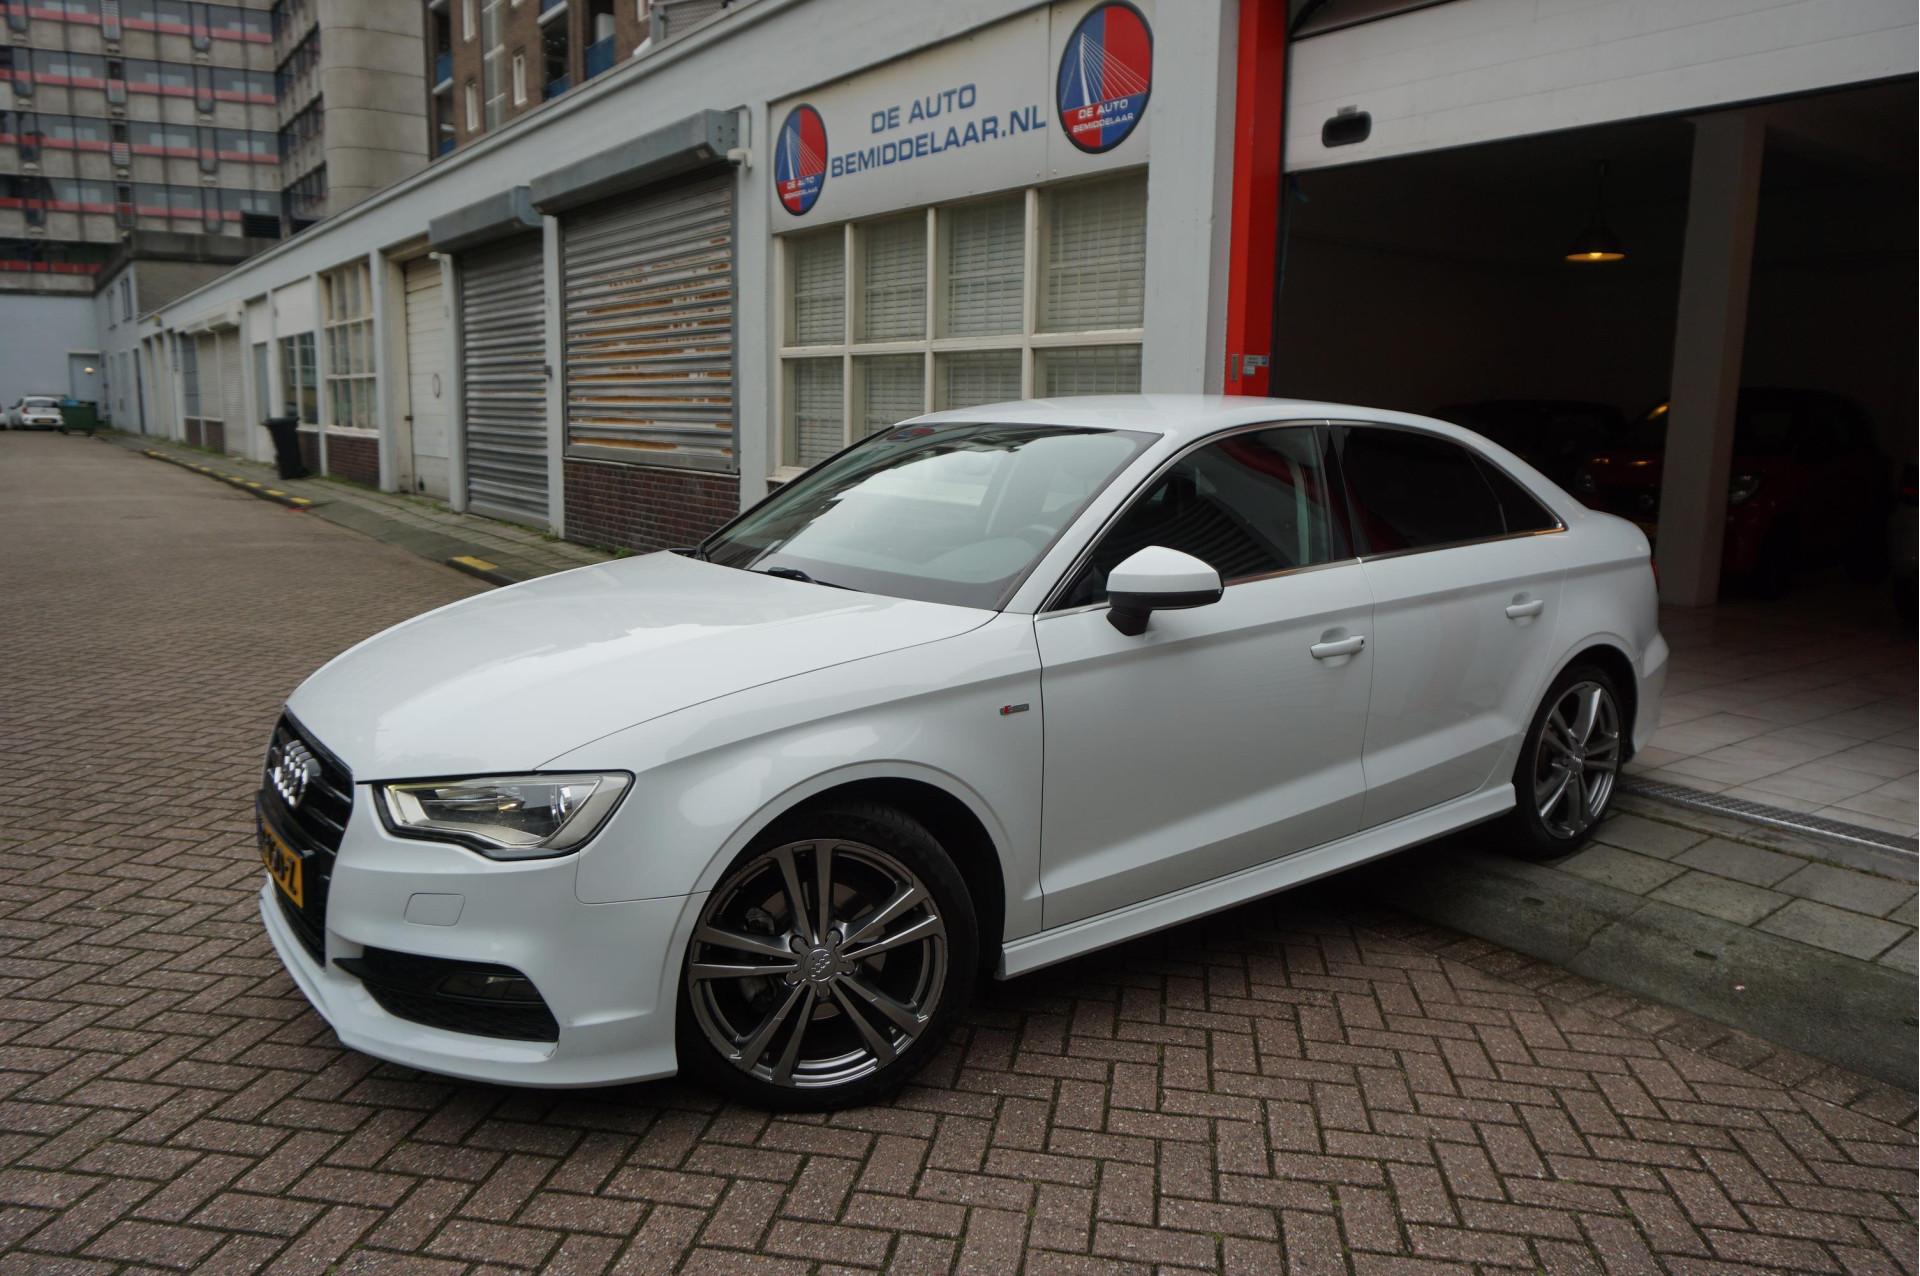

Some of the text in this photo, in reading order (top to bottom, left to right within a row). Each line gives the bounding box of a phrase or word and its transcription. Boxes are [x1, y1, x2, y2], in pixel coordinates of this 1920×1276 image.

[871, 83, 976, 134] DE AUTO
[1073, 112, 1134, 133] BEMIDDELAAR
[1078, 98, 1129, 119] DE AUTO
[831, 105, 1046, 178] BEMIDDELAAR.NL
